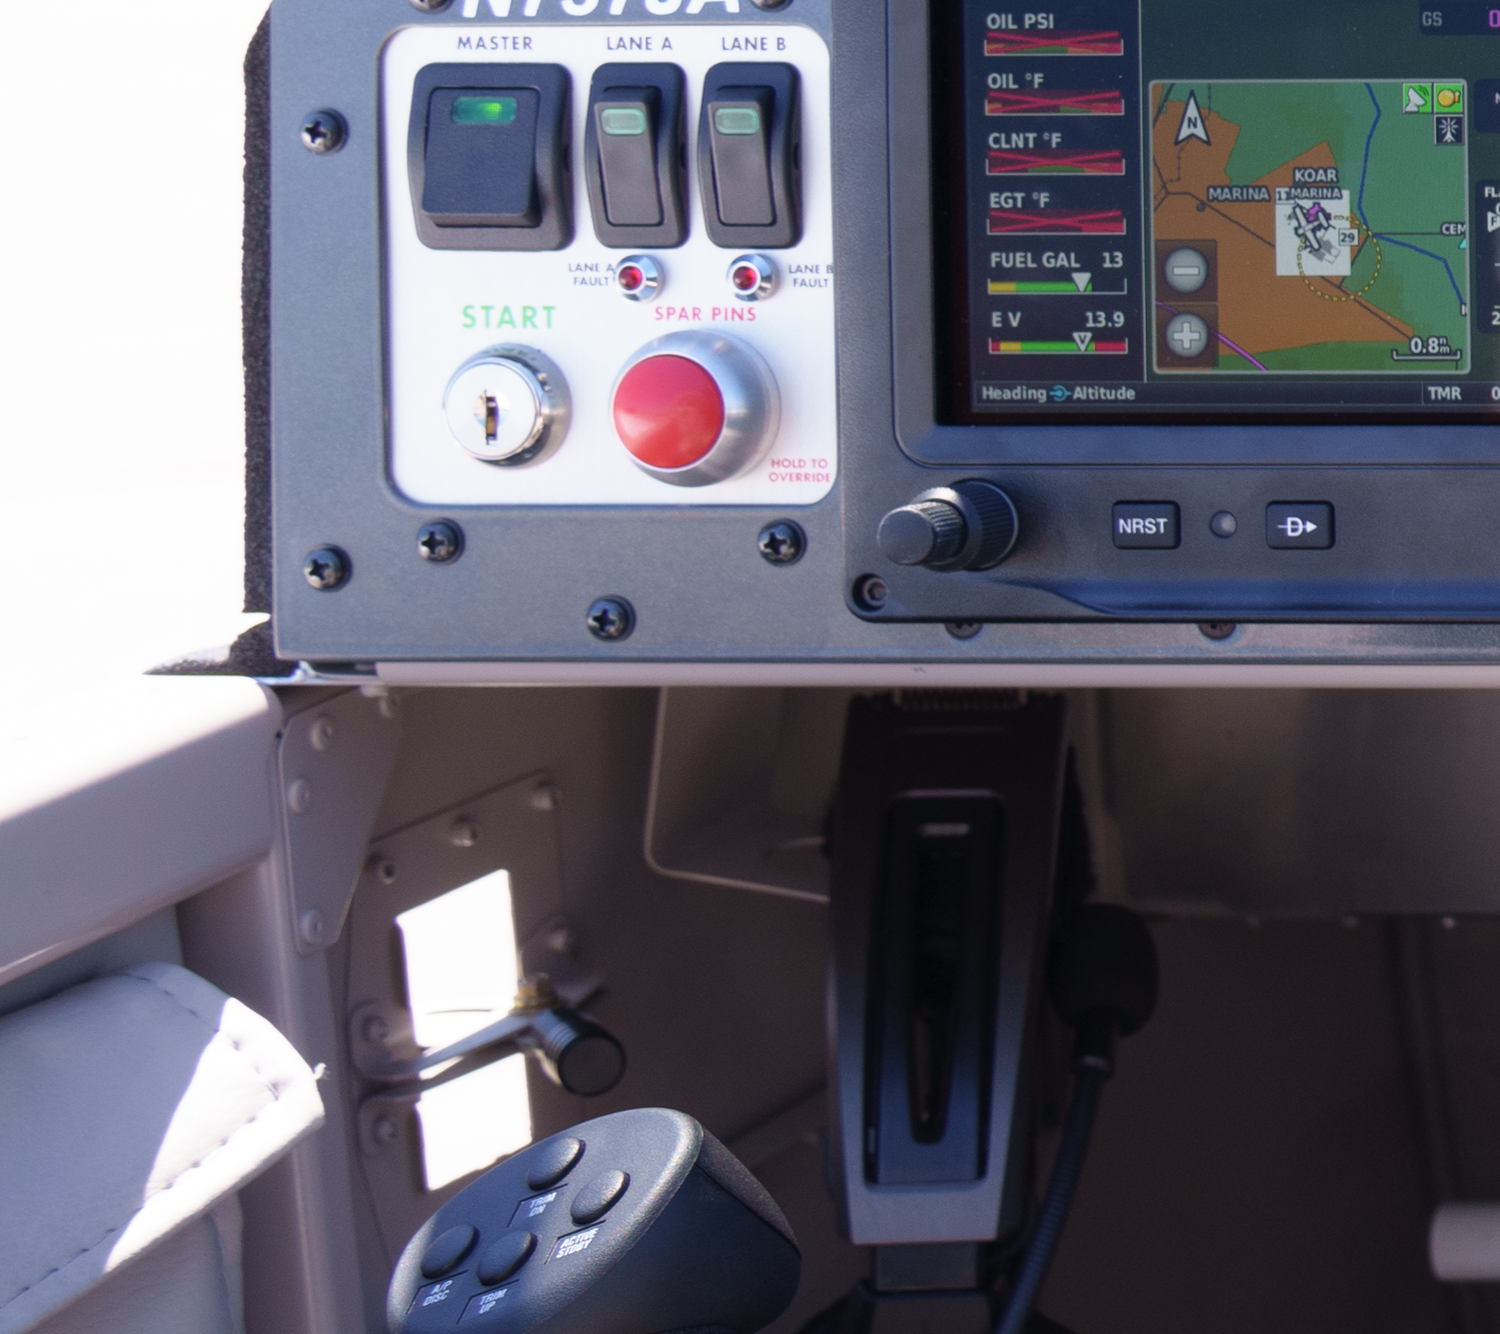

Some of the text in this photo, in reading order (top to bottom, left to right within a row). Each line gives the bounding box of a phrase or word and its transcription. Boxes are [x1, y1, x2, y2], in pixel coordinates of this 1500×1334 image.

[457, 36, 533, 52] MASTER
[606, 36, 674, 51] LANE A
[991, 252, 1123, 267] FUEL GAL 13
[462, 305, 555, 328] START
[655, 307, 756, 321] SPAR PINS
[983, 386, 1135, 403] Heading Altitude
[1119, 518, 1167, 534] NRST
